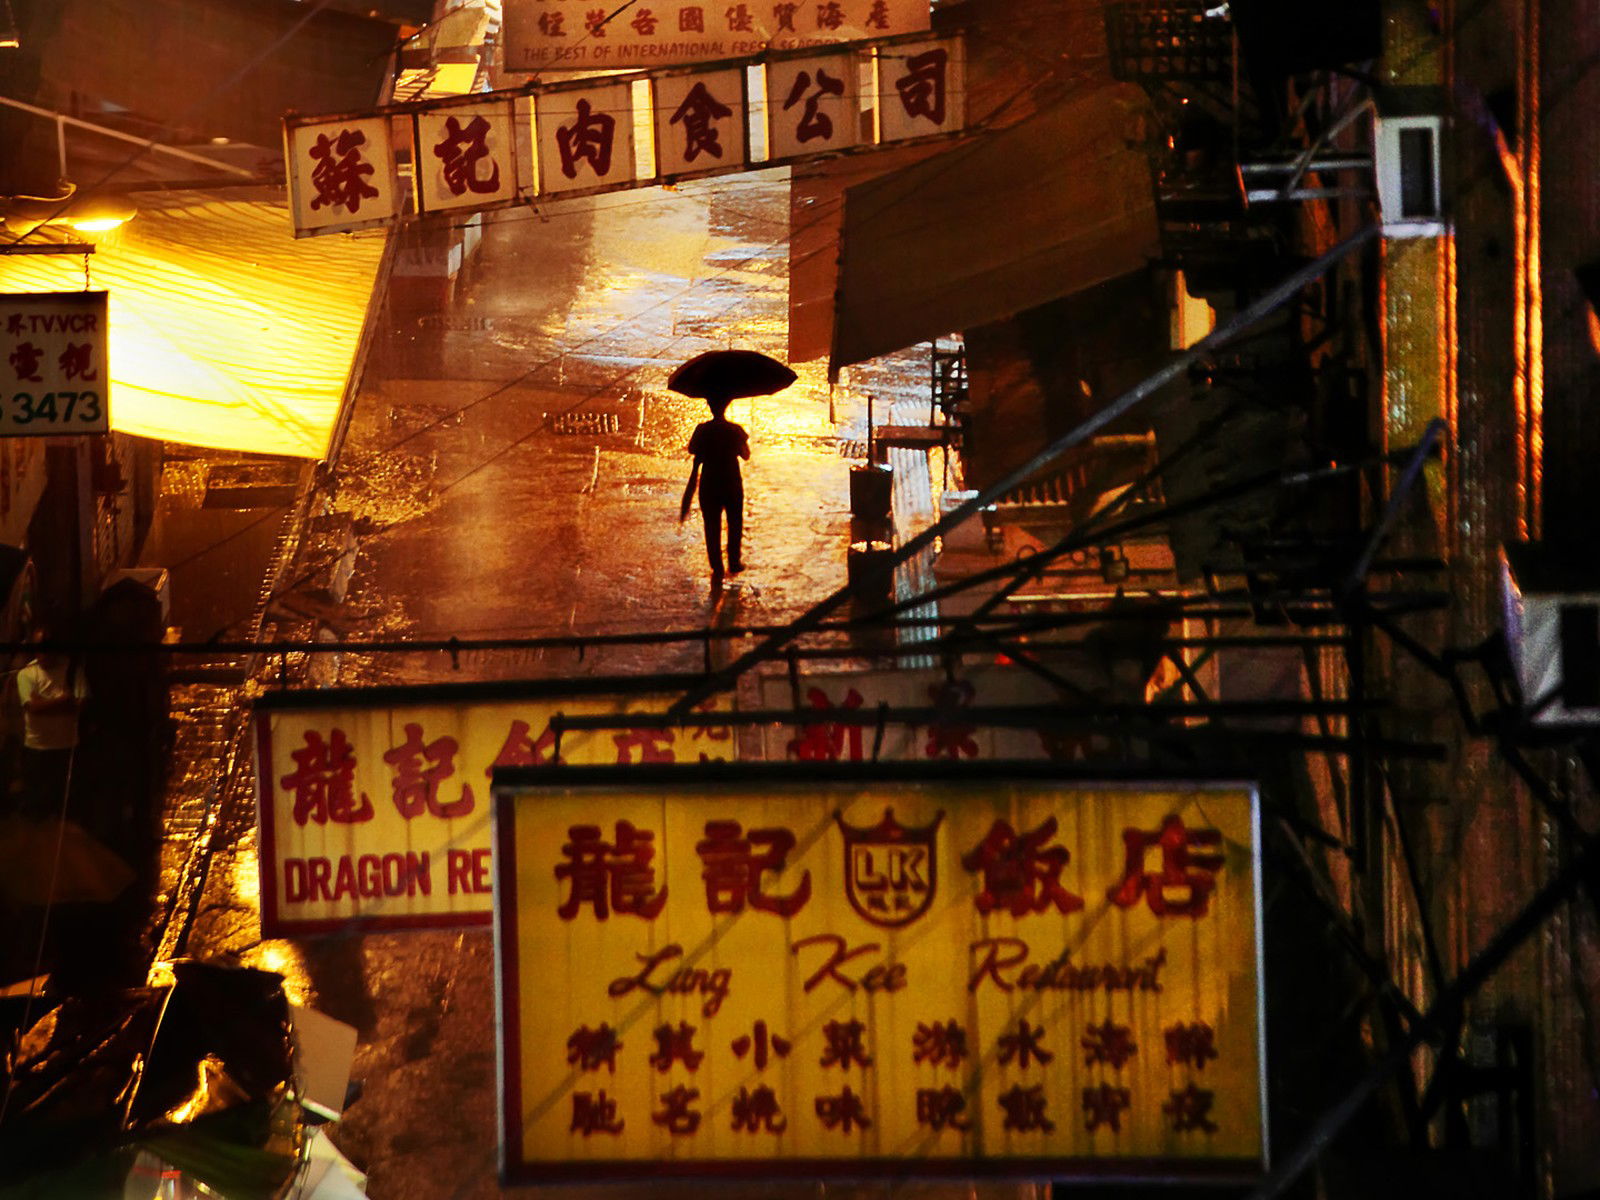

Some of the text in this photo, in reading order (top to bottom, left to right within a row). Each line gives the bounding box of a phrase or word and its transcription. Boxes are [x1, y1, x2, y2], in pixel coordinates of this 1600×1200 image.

[523, 47, 549, 61] THE
[555, 45, 587, 61] BEST
[593, 45, 611, 59] OF
[618, 40, 725, 58] INTERNATIONAL
[309, 48, 949, 214] 蘇記肉食公司
[9, 342, 98, 382] 電視
[12, 391, 101, 425] 3473
[285, 851, 431, 905] DRAGON
[607, 933, 1168, 1019] Lung Kee Restaurant
